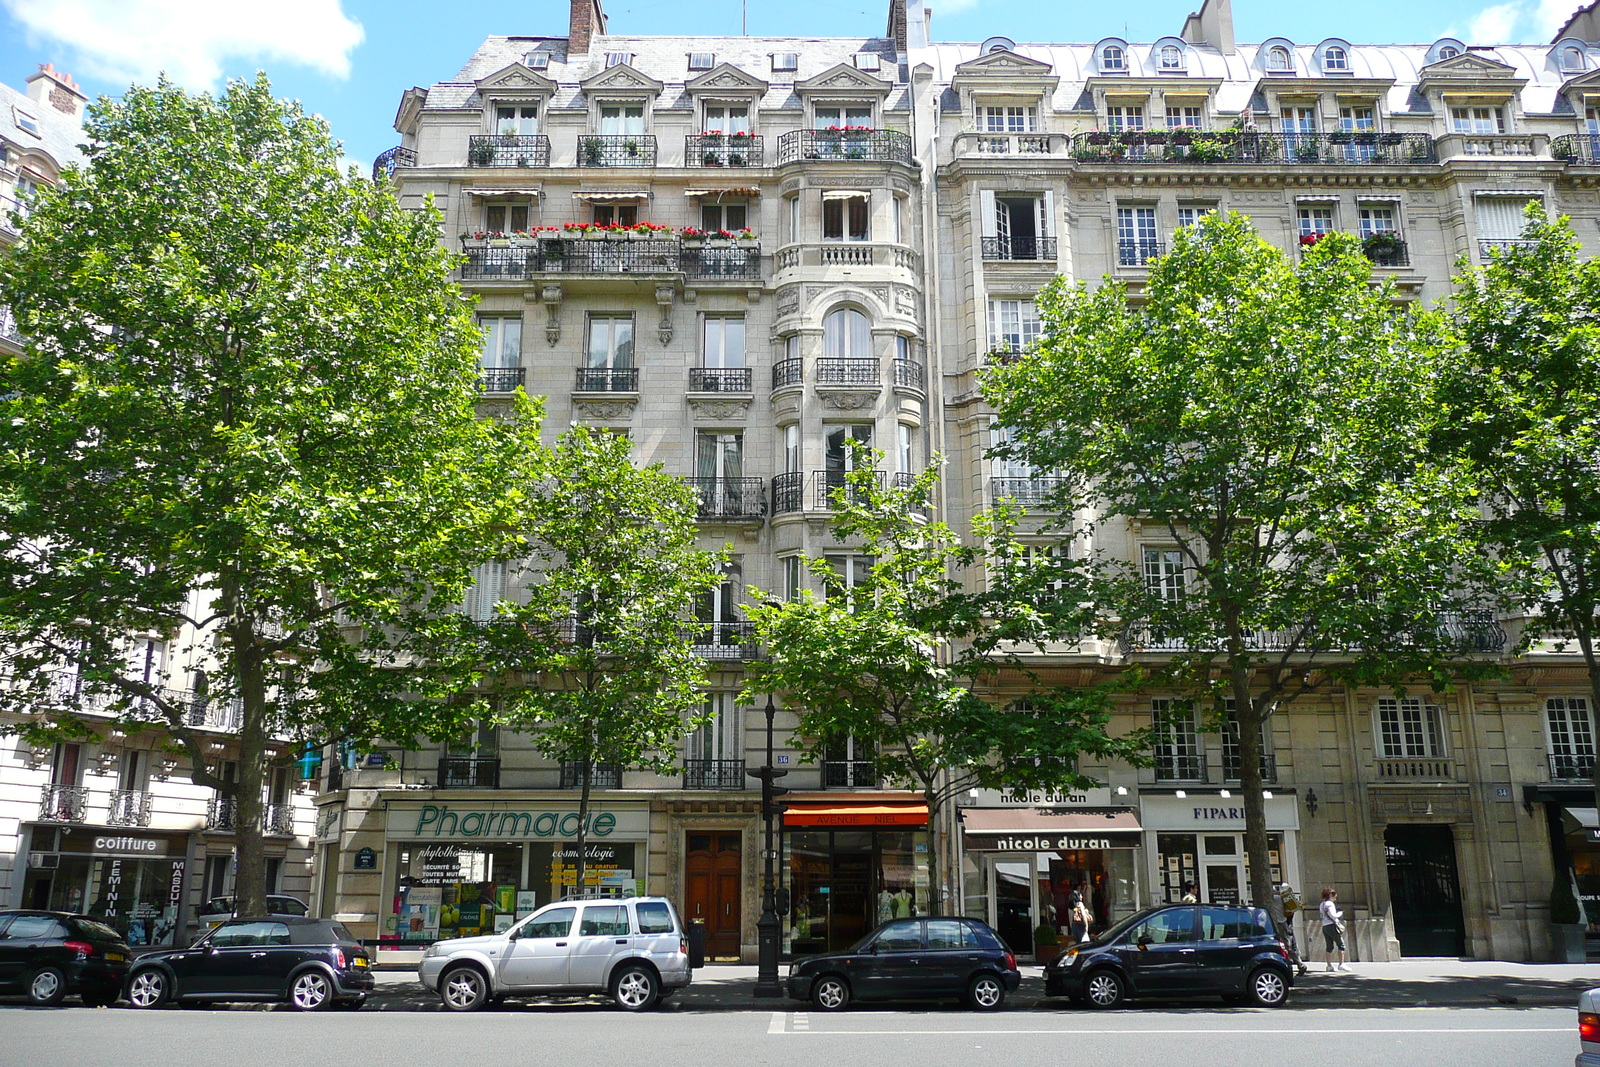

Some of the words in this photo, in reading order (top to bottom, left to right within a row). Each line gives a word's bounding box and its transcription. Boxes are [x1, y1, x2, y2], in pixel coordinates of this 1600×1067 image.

[415, 805, 617, 837] Pharmacie
[816, 815, 860, 824] AVENUE
[874, 815, 898, 823] NIEL
[95, 836, 157, 851] coiffure
[997, 836, 1050, 850] nicole
[1057, 836, 1111, 849] duran
[552, 844, 616, 861] cosmologie
[105, 860, 122, 917] FEMININ
